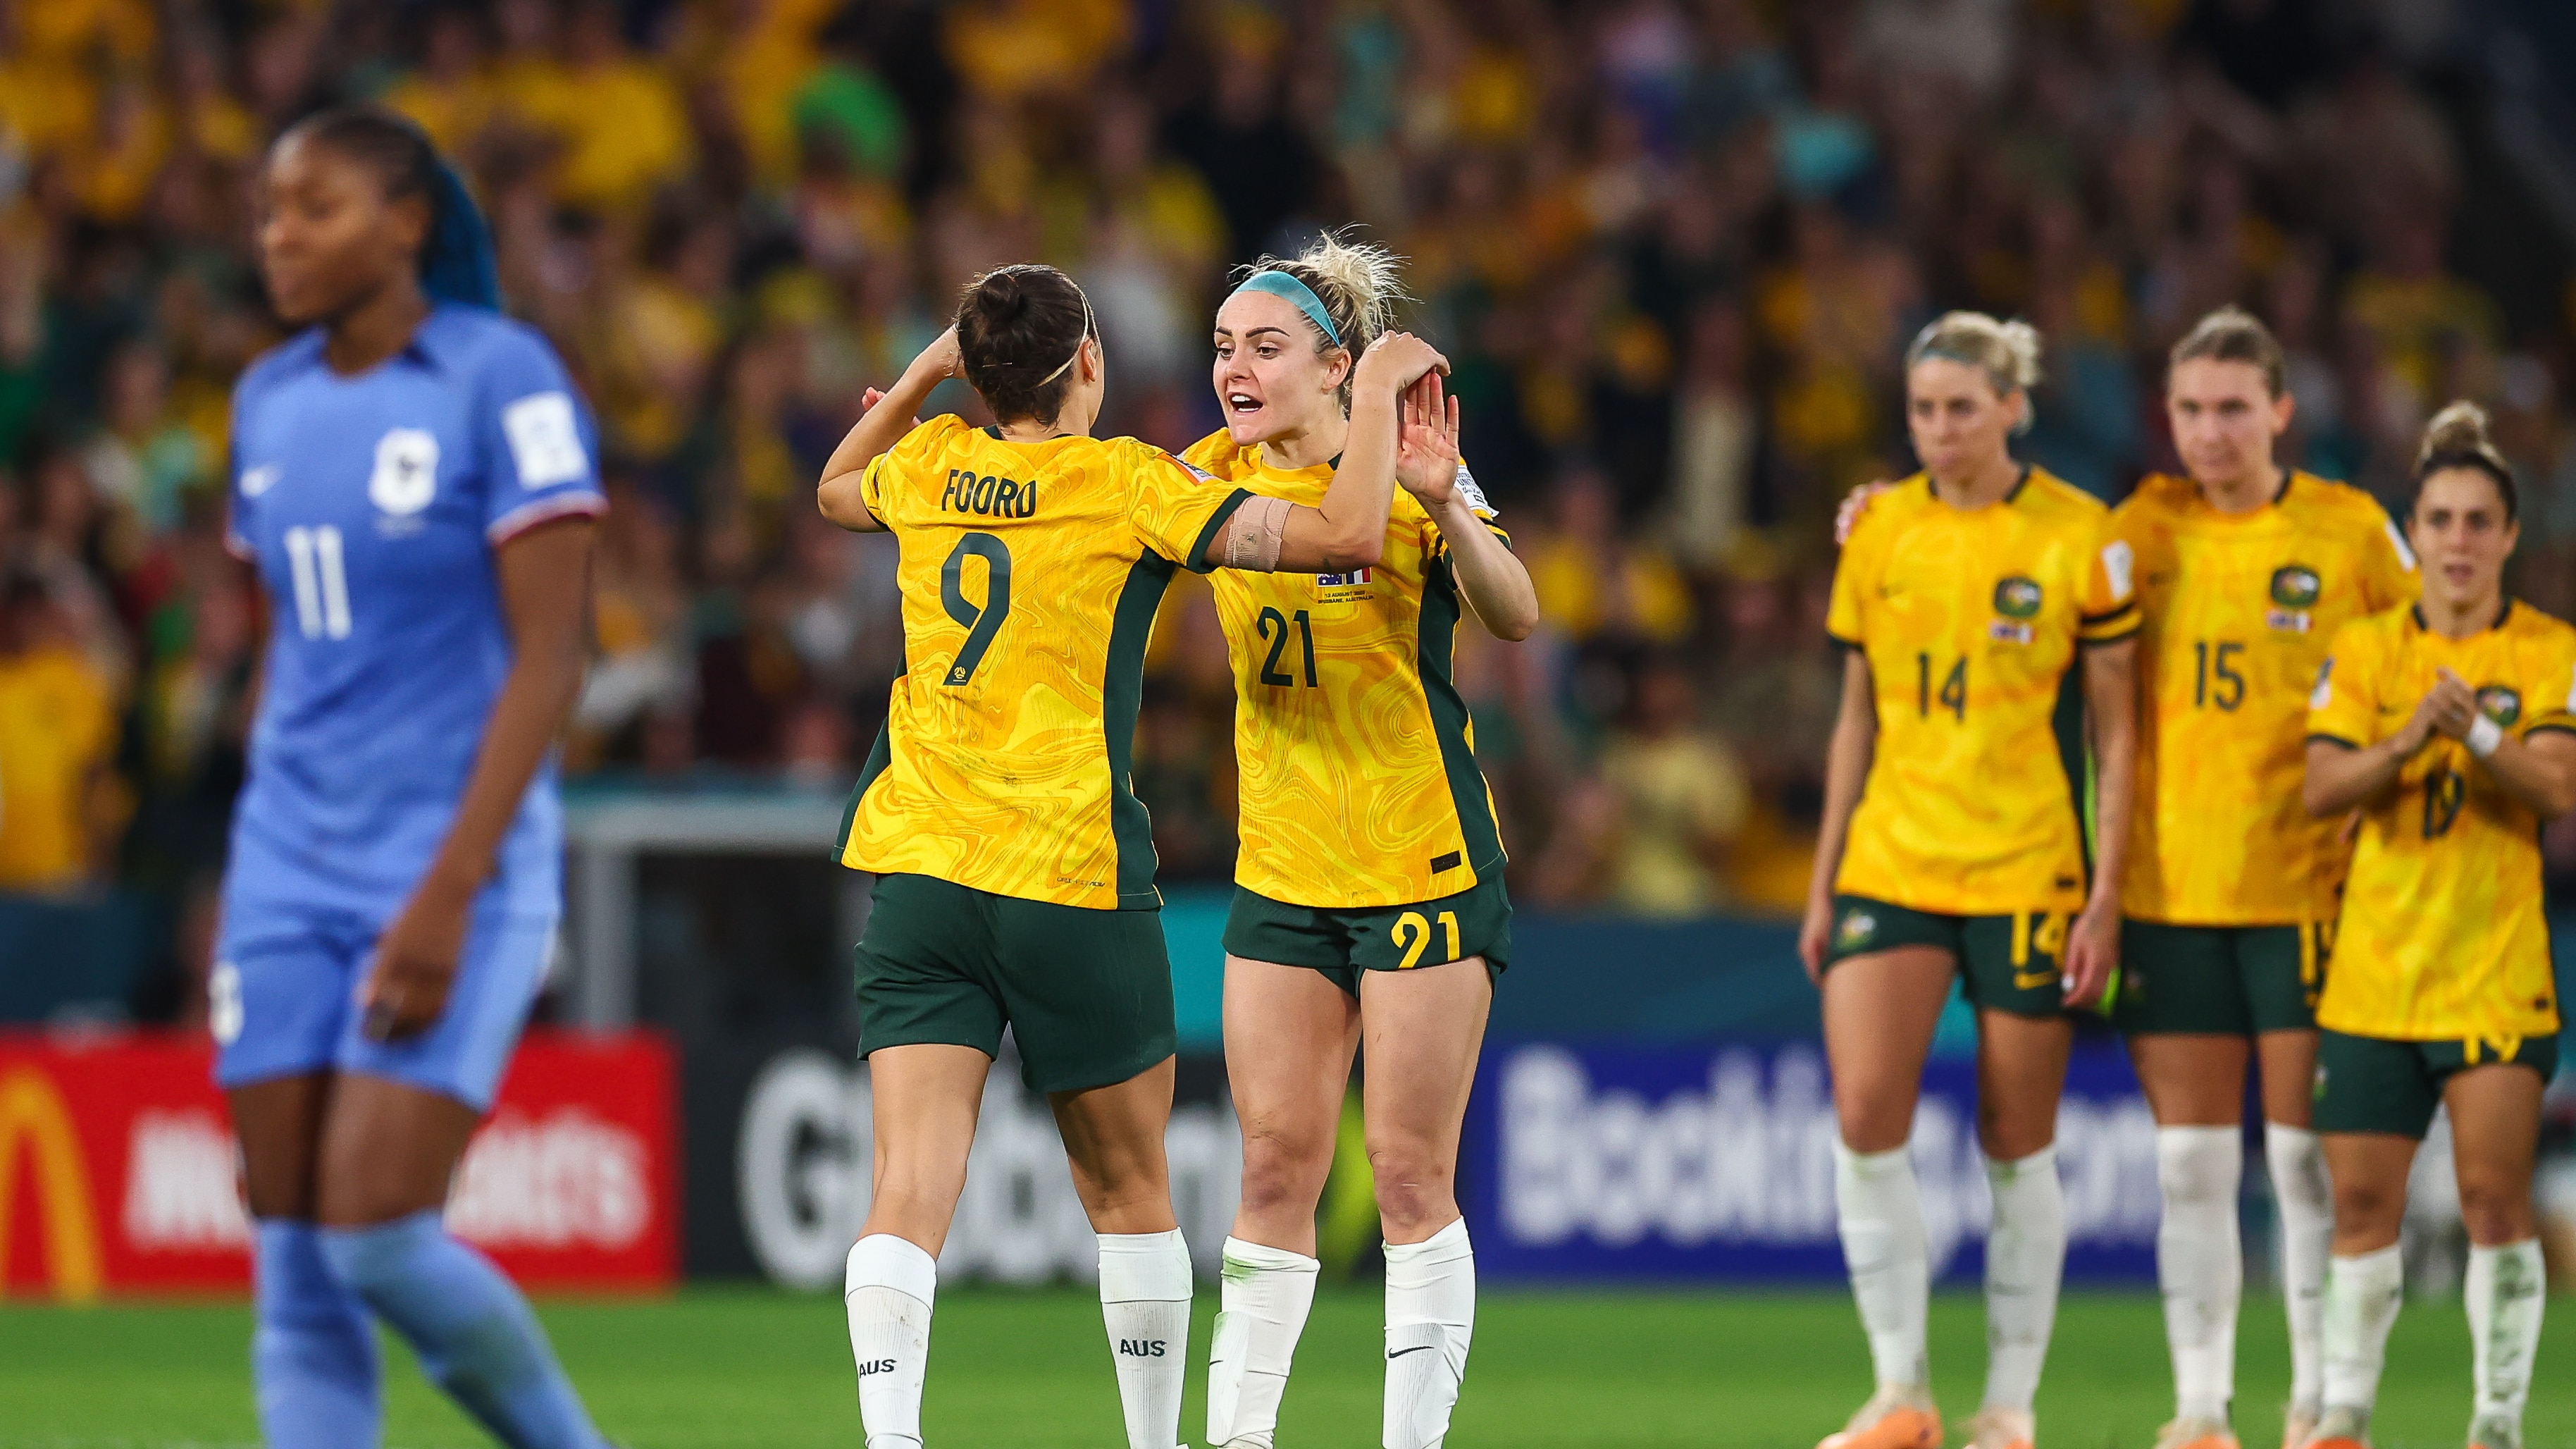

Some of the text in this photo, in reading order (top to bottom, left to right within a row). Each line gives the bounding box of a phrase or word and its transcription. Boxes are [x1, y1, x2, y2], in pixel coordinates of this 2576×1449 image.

[941, 469, 1036, 518] FOORD
[284, 524, 351, 640] 11
[941, 532, 1011, 685] 9
[1256, 606, 1318, 688] 21
[2193, 641, 2245, 711] 15
[1915, 652, 1967, 723] 14
[1390, 911, 1461, 968] 21
[2011, 906, 2069, 970] 14
[859, 1359, 898, 1379] AUS
[1120, 1338, 1168, 1357] AUS
